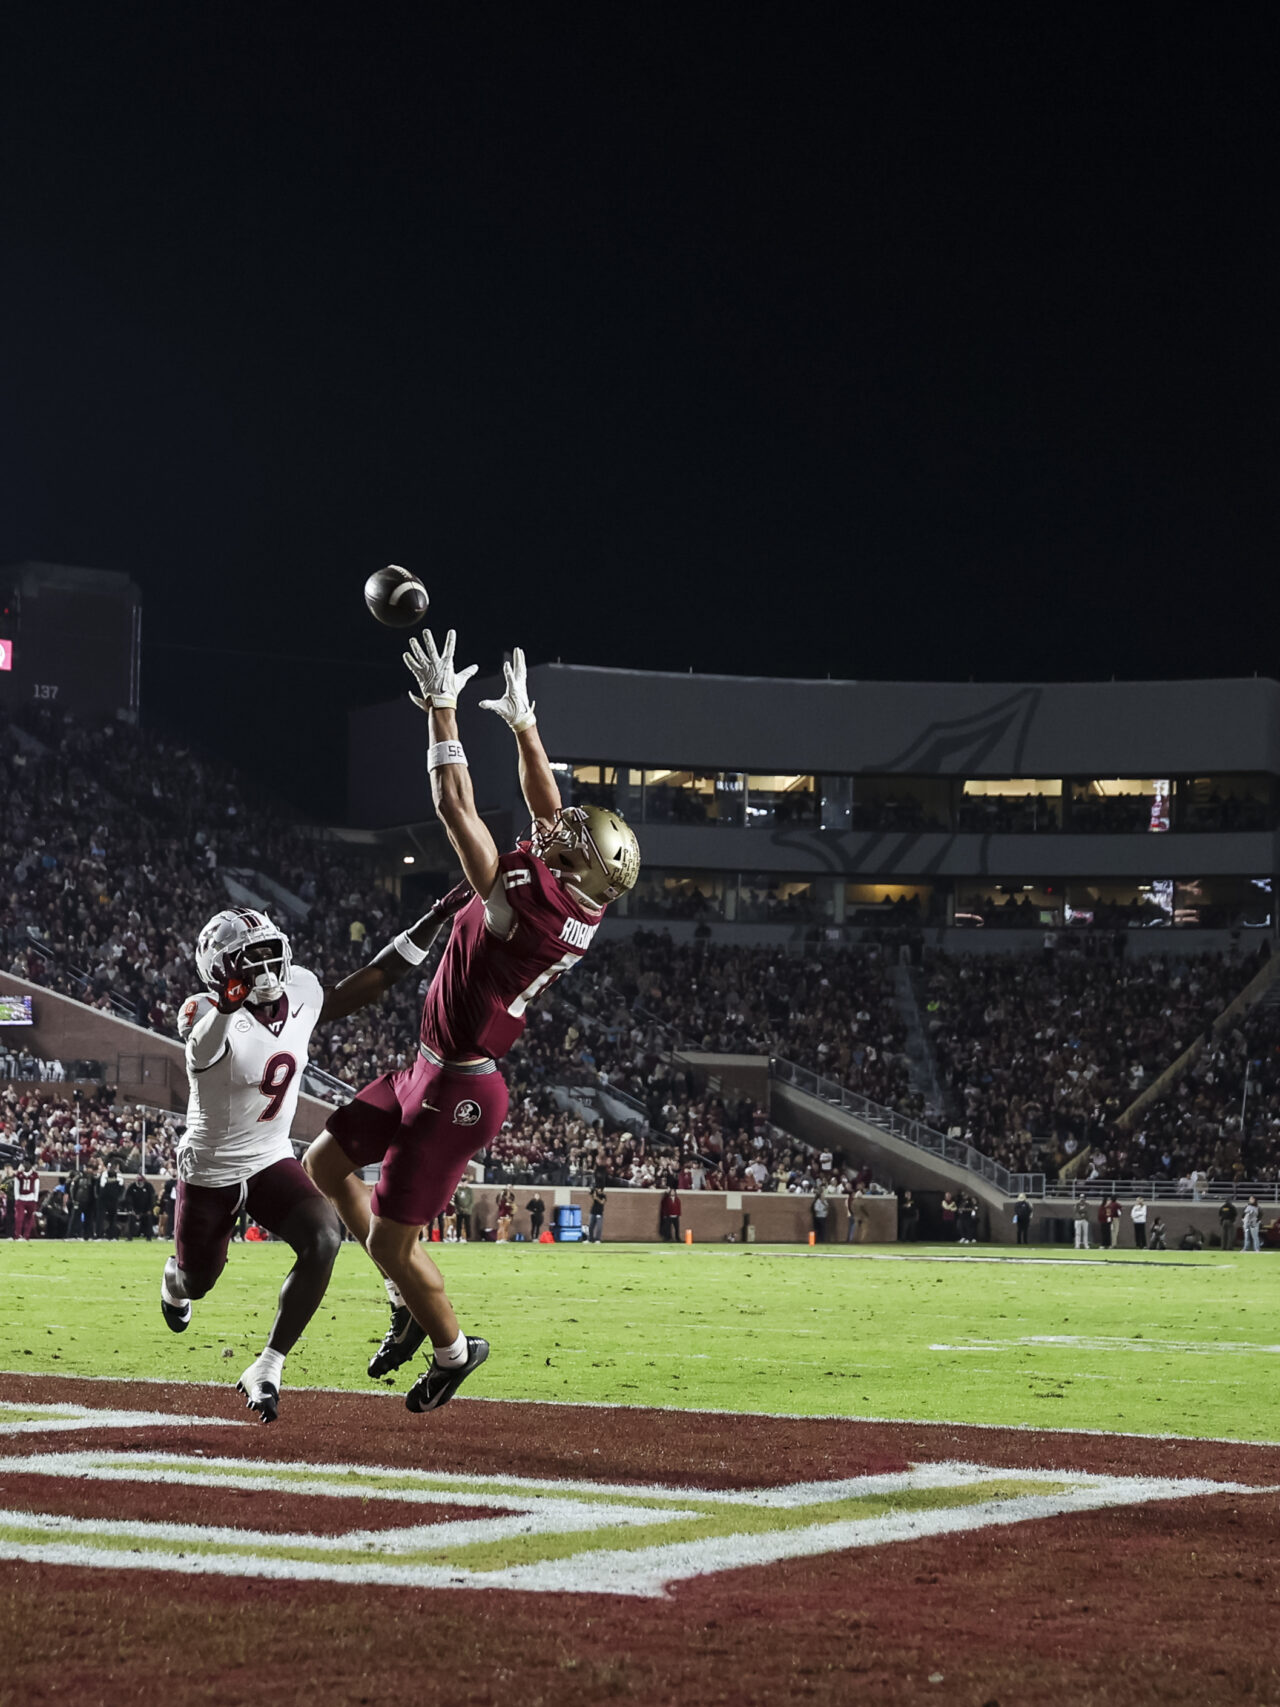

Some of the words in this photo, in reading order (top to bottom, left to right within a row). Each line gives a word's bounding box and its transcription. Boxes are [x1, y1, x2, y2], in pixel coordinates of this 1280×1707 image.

[33, 683, 59, 700] 137
[227, 985, 242, 996] VT
[185, 1001, 197, 1027] 9
[268, 1021, 284, 1032] VT
[256, 1050, 297, 1122] 9
